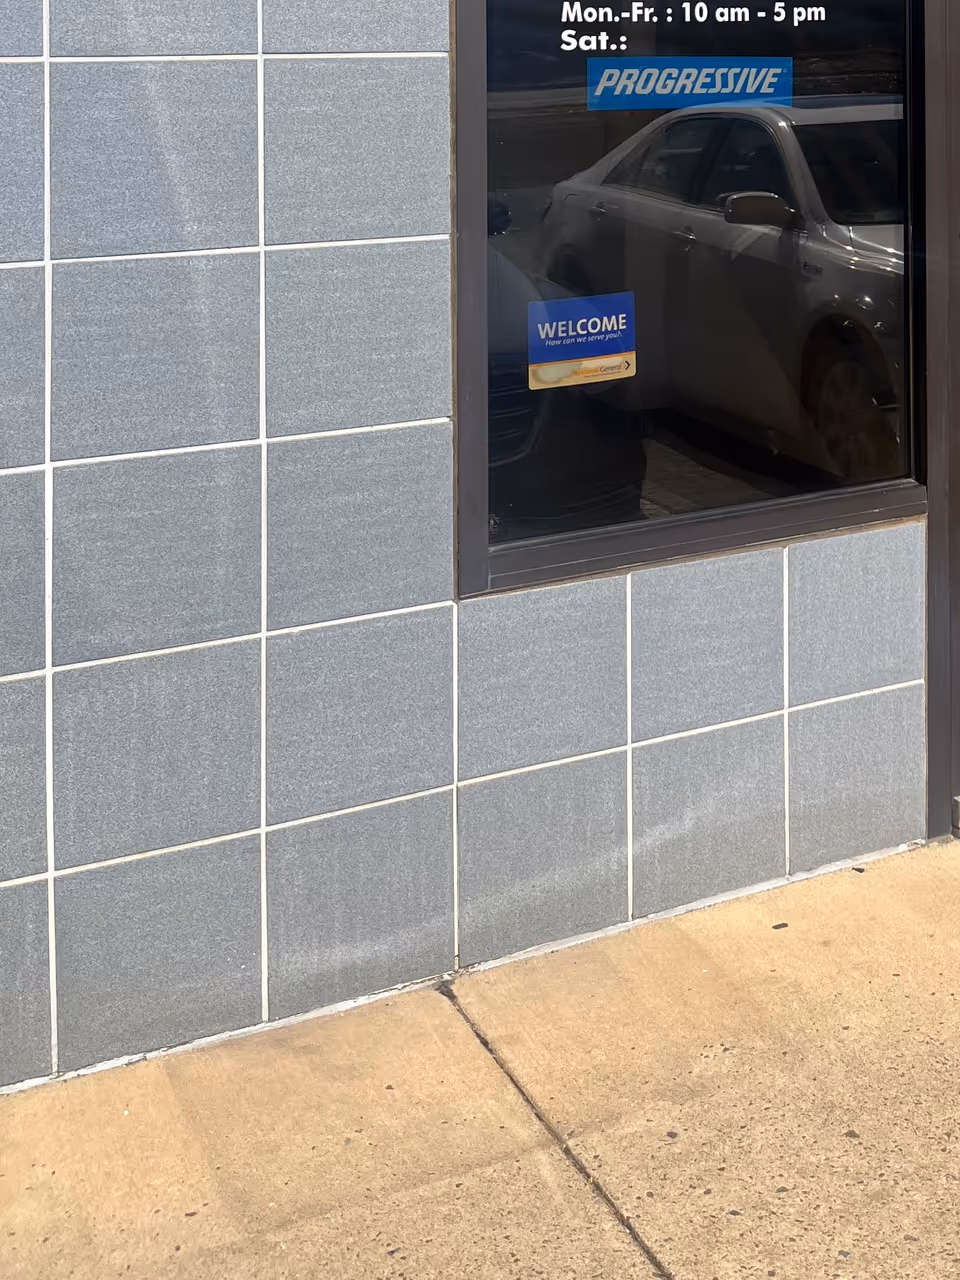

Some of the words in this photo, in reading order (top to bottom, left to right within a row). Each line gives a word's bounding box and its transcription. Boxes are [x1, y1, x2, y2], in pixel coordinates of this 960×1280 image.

[561, 1, 658, 22] Mon.-Fr.
[681, 2, 708, 22] 10
[715, 5, 750, 22] am
[773, 2, 786, 22] 5
[793, 5, 826, 26] pm
[560, 30, 628, 51] Sat.:
[594, 67, 783, 96] PROGRESSIVE
[537, 314, 627, 339] WELCOME
[588, 334, 605, 342] serve
